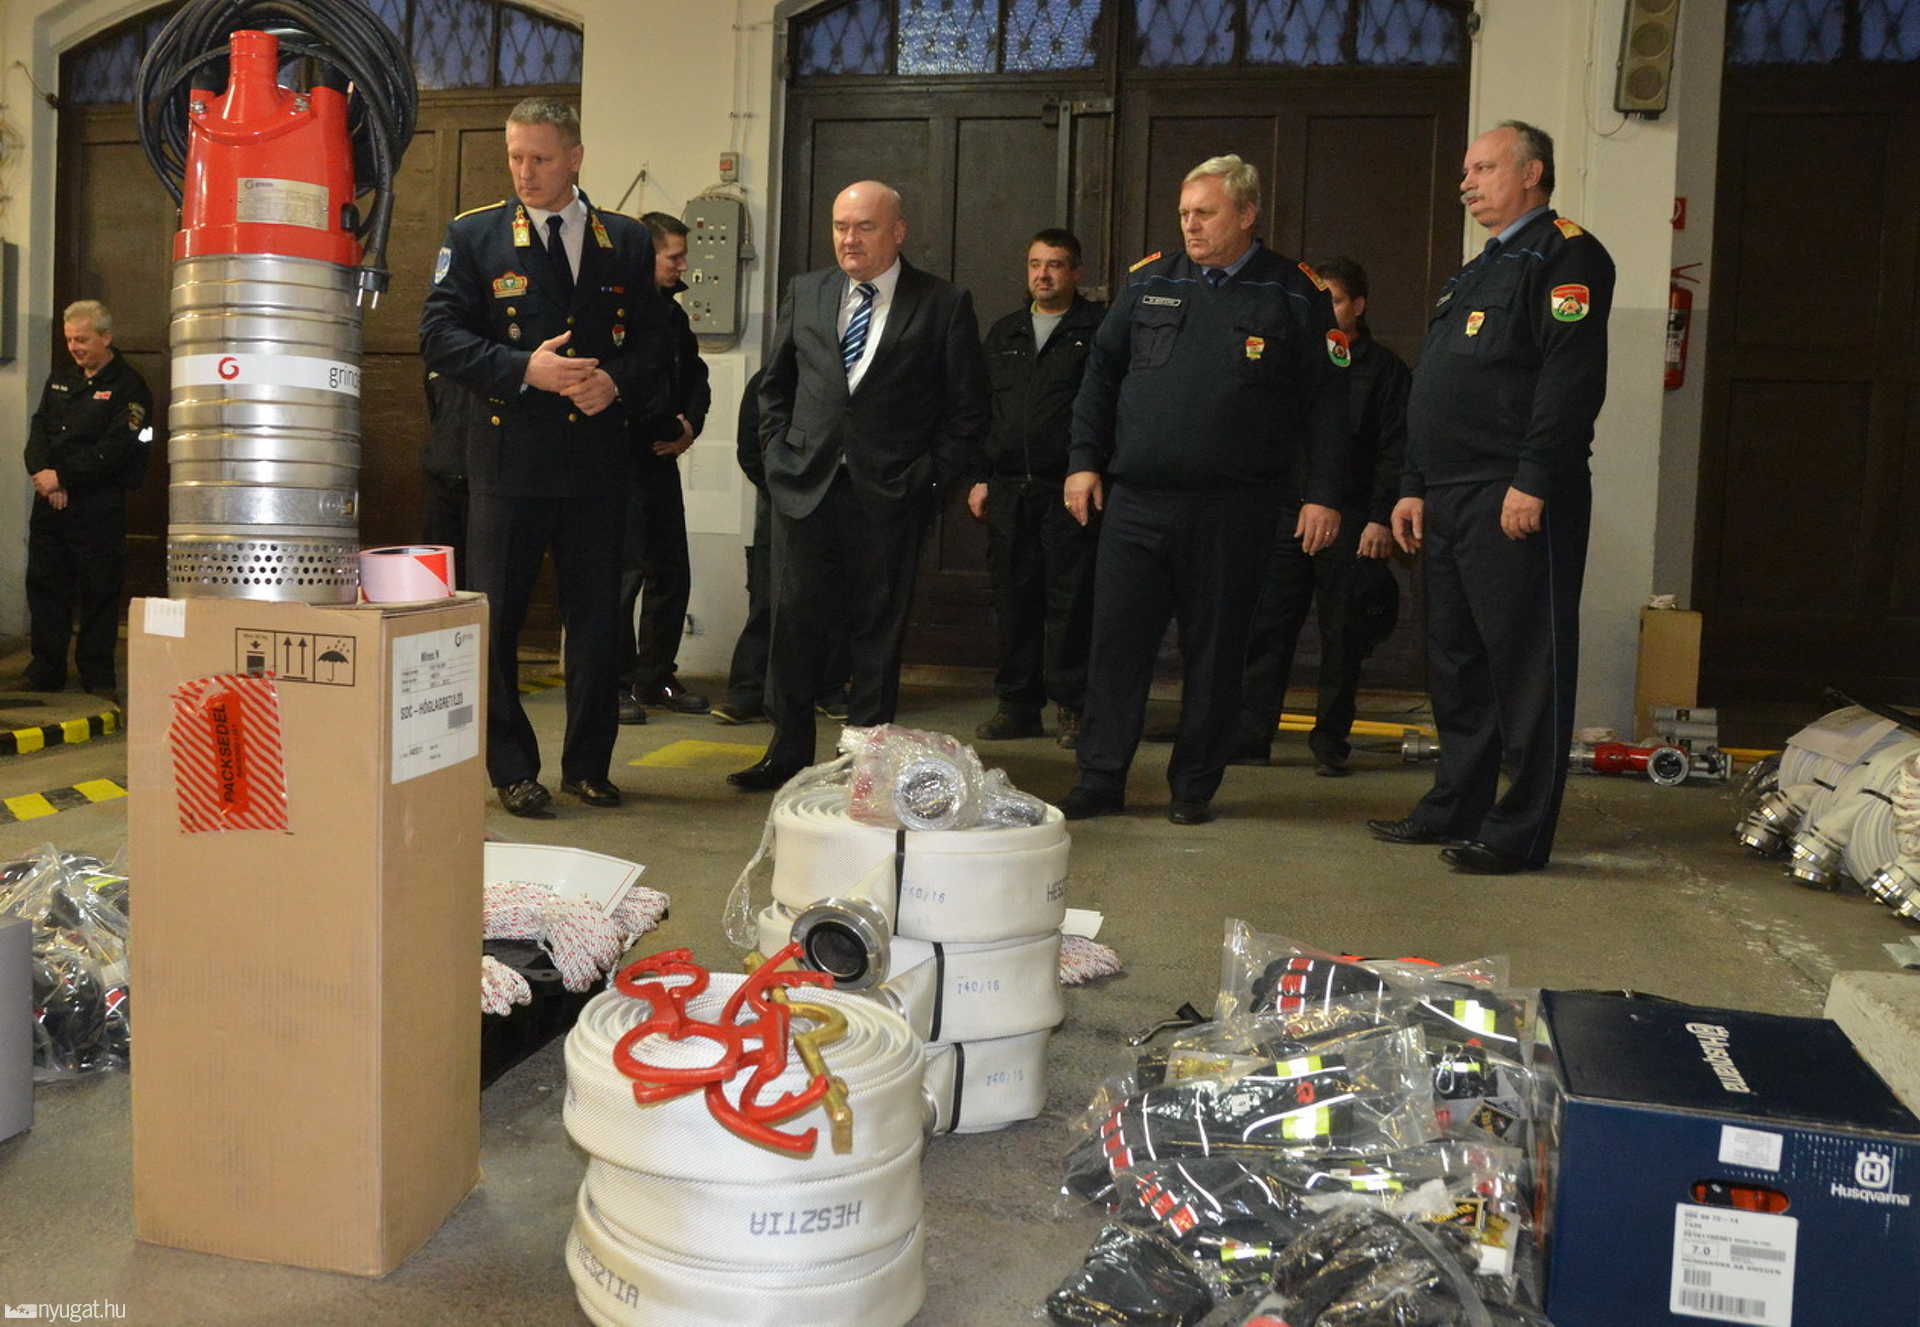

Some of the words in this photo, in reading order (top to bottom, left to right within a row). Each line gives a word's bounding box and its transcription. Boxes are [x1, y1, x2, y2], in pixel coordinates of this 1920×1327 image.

[213, 702, 234, 804] PACKSEDEL
[1831, 1182, 1911, 1206] Husqvarna
[750, 1200, 862, 1235] HESZTIA
